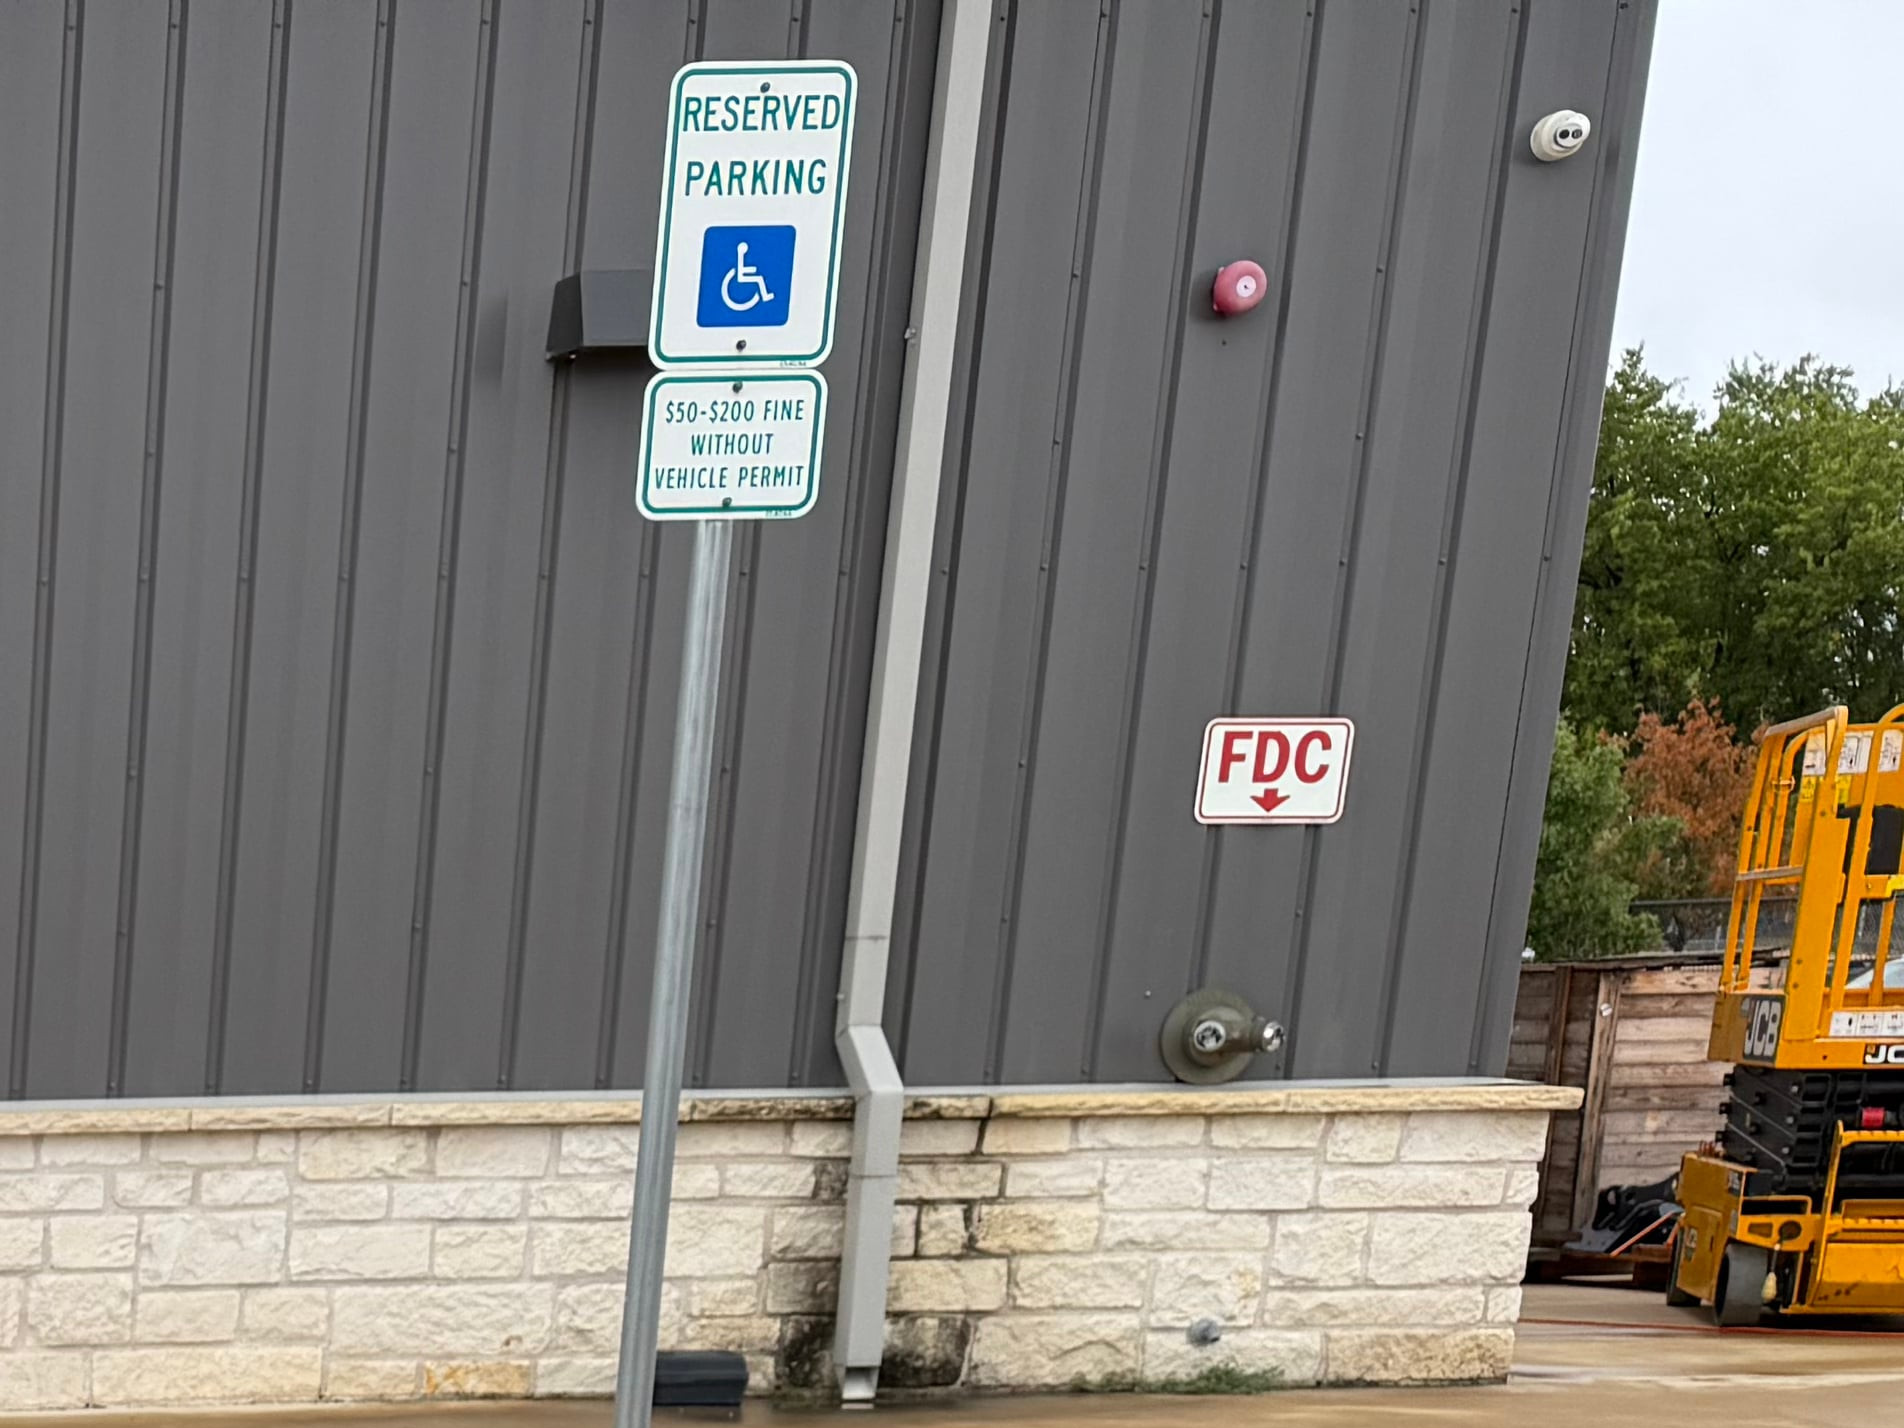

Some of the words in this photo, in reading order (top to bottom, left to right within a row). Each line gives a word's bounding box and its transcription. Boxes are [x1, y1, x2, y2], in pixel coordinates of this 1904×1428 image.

[682, 94, 841, 132] RESERVED
[684, 158, 827, 196] PARKING
[665, 400, 755, 424] $50-$200
[763, 400, 805, 421] FINE
[691, 433, 774, 456] WITHOUT
[655, 467, 729, 489] VEHICLE
[738, 466, 805, 487] PERMIT
[1218, 730, 1332, 783] FDC
